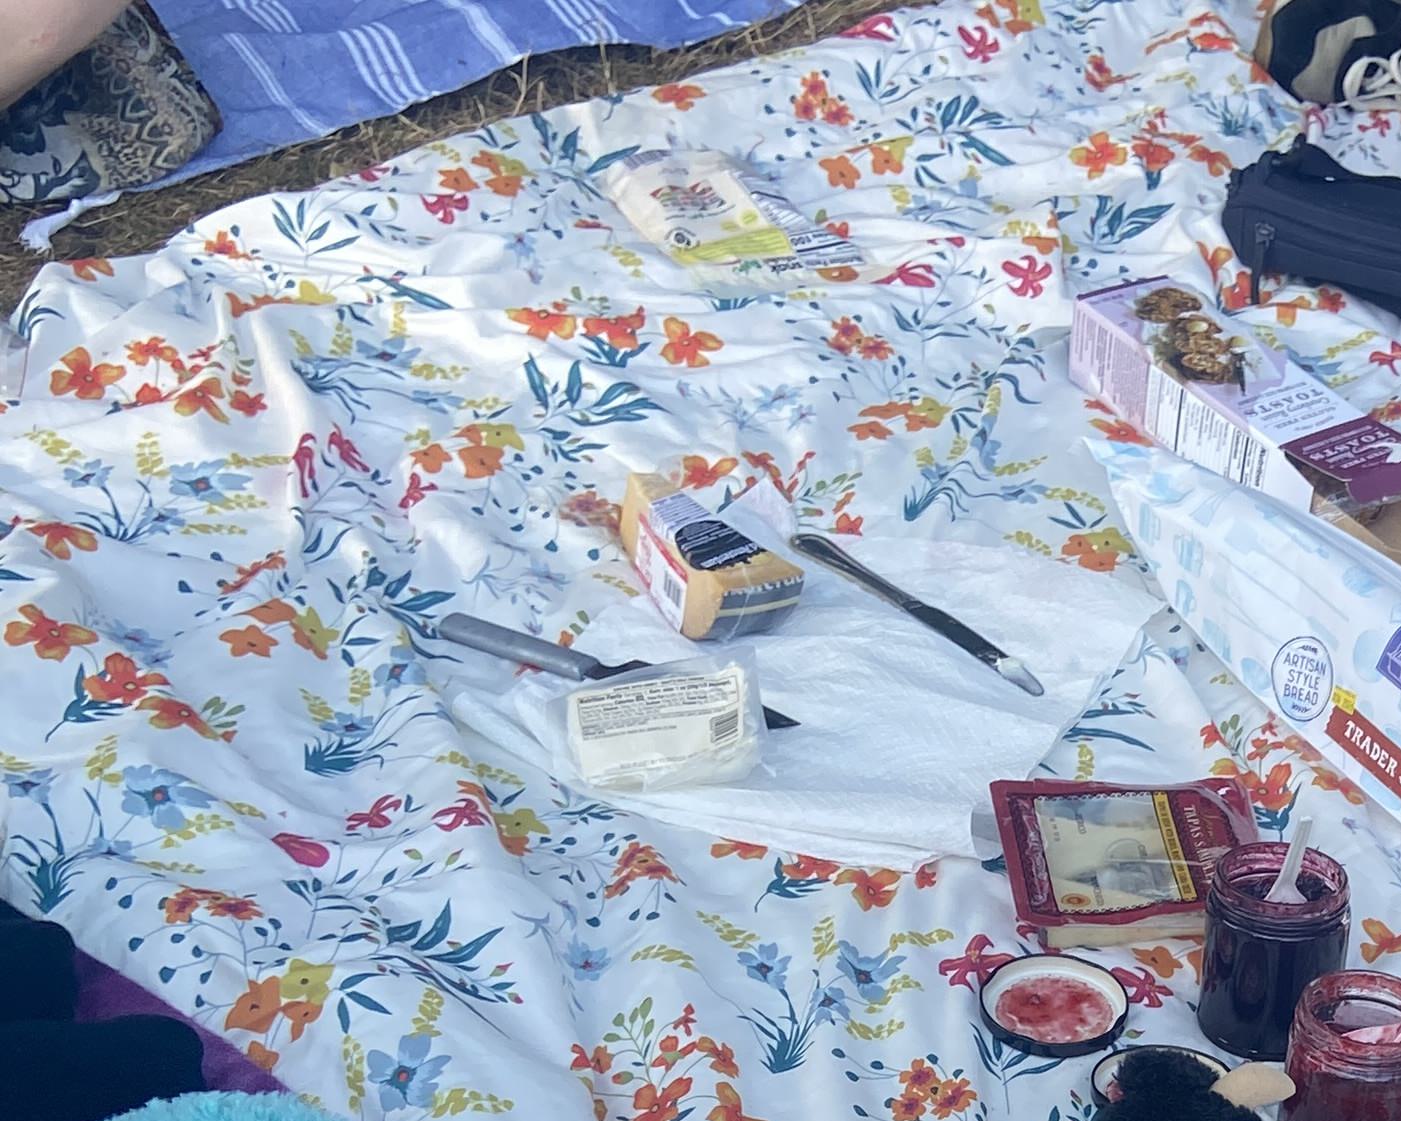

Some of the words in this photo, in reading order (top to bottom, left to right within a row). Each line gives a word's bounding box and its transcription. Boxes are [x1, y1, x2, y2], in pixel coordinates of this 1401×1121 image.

[1243, 387, 1323, 419] TOASTS
[1308, 429, 1389, 460] TOASTS
[1283, 652, 1327, 675] ARTISAN
[1283, 684, 1319, 706] BREAD
[1287, 670, 1321, 691] STYLE
[1343, 720, 1398, 778] TRADER
[1183, 804, 1204, 838] TAPAS
